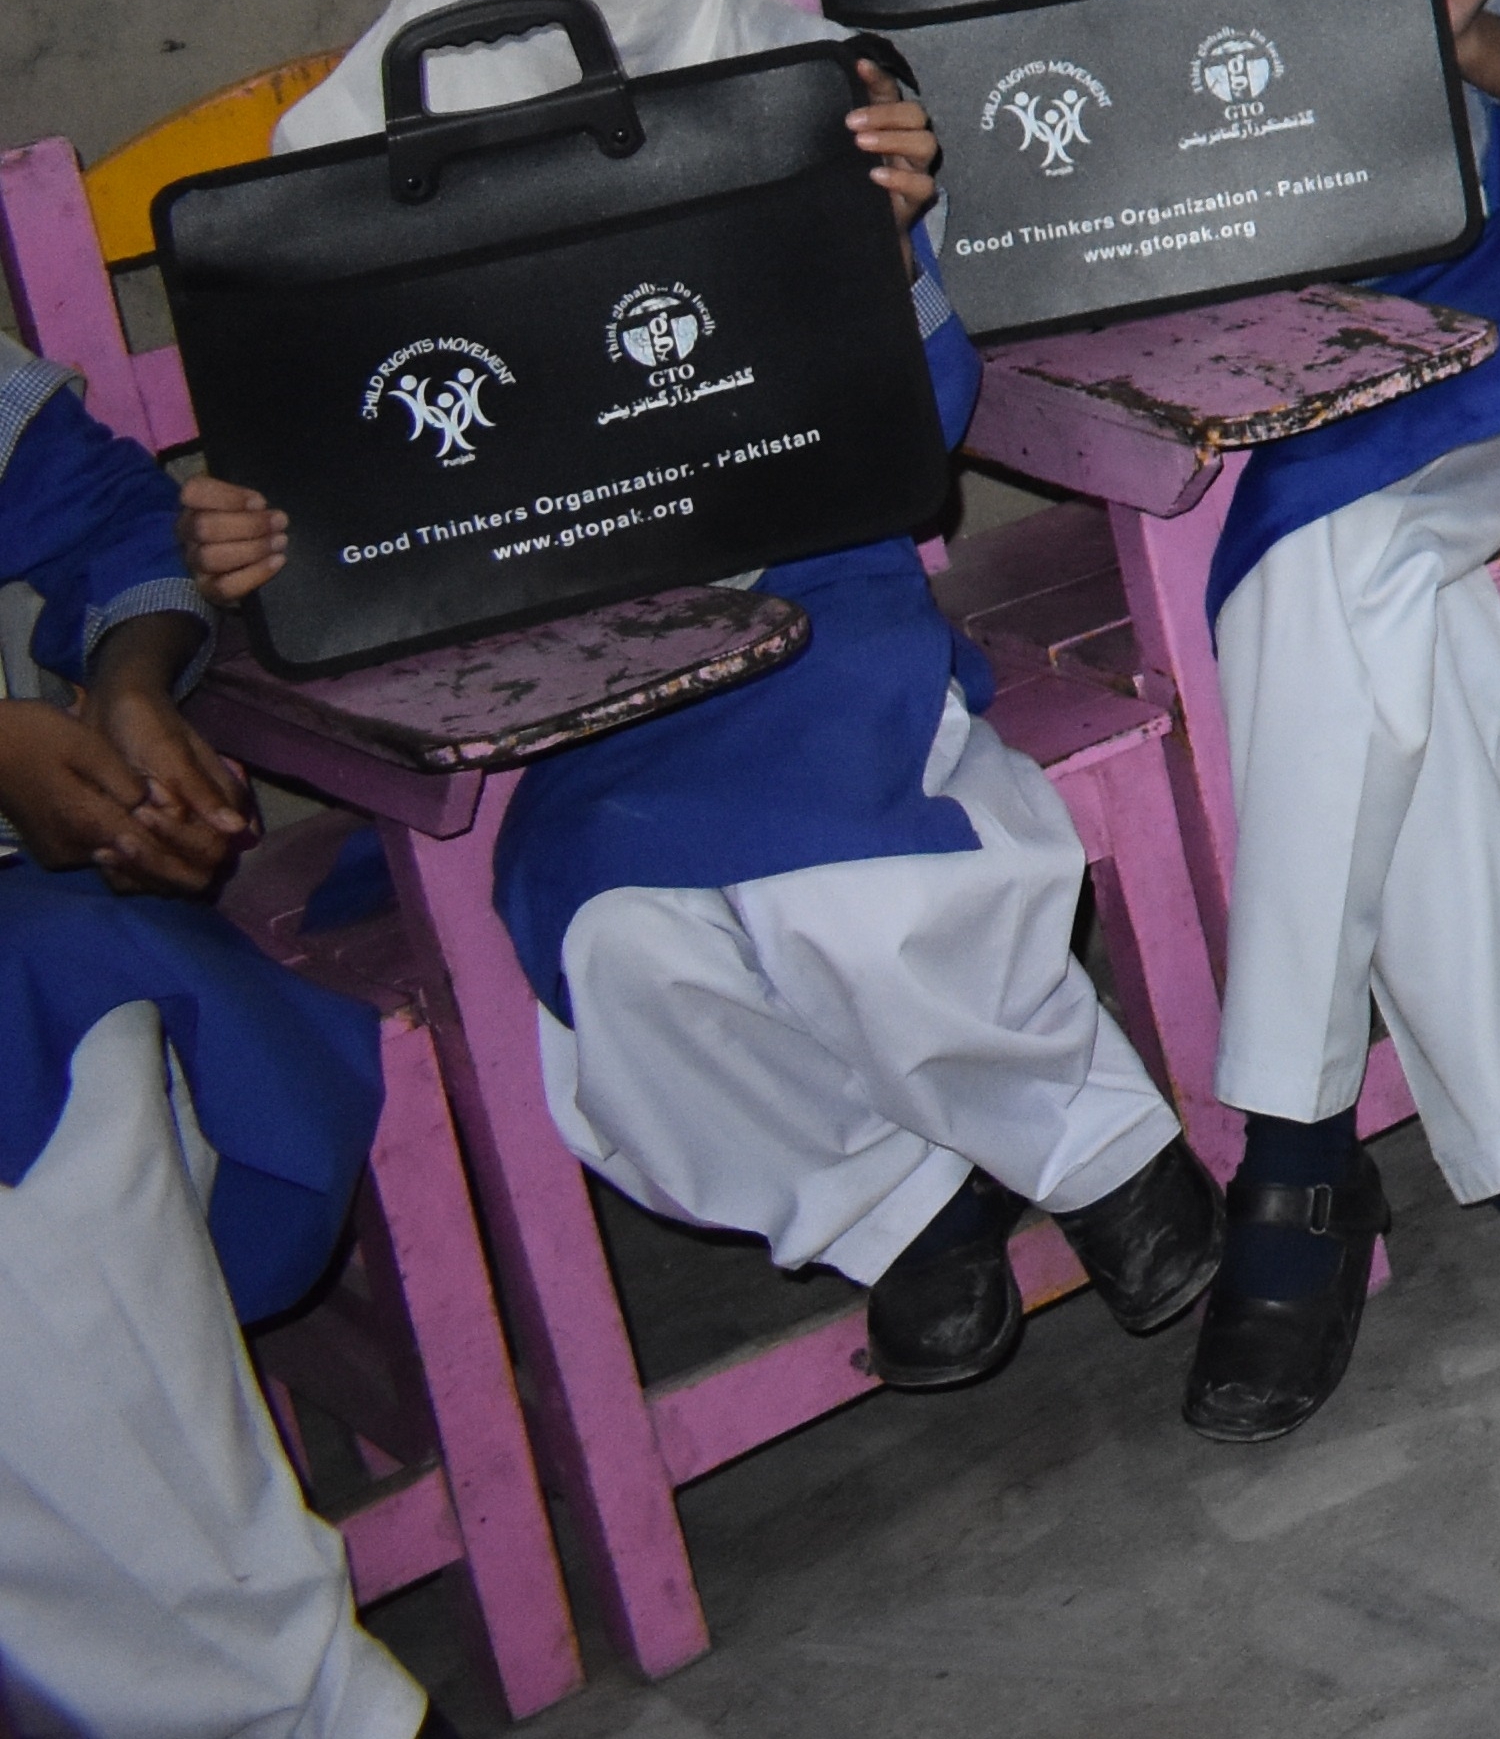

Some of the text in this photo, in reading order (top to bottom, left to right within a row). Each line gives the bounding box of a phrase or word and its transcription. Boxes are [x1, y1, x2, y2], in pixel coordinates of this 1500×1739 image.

[981, 60, 1114, 132] CHILD RIGHTS MOVEMENT
[1224, 101, 1266, 122] GTO
[955, 232, 1015, 258] Good
[1018, 214, 1117, 245] Thinkers
[1120, 185, 1260, 228] Organization
[1277, 167, 1371, 199] Pakistan
[1083, 217, 1258, 265] www.gtopak.org
[605, 322, 623, 363] Think
[672, 281, 692, 297] Do
[361, 335, 518, 420] CHILD RIGHTS MOVEMENT
[648, 362, 696, 388] GTO
[341, 531, 411, 566] Good
[416, 503, 529, 547] Thinkers
[492, 495, 696, 562] www.gtopak.org
